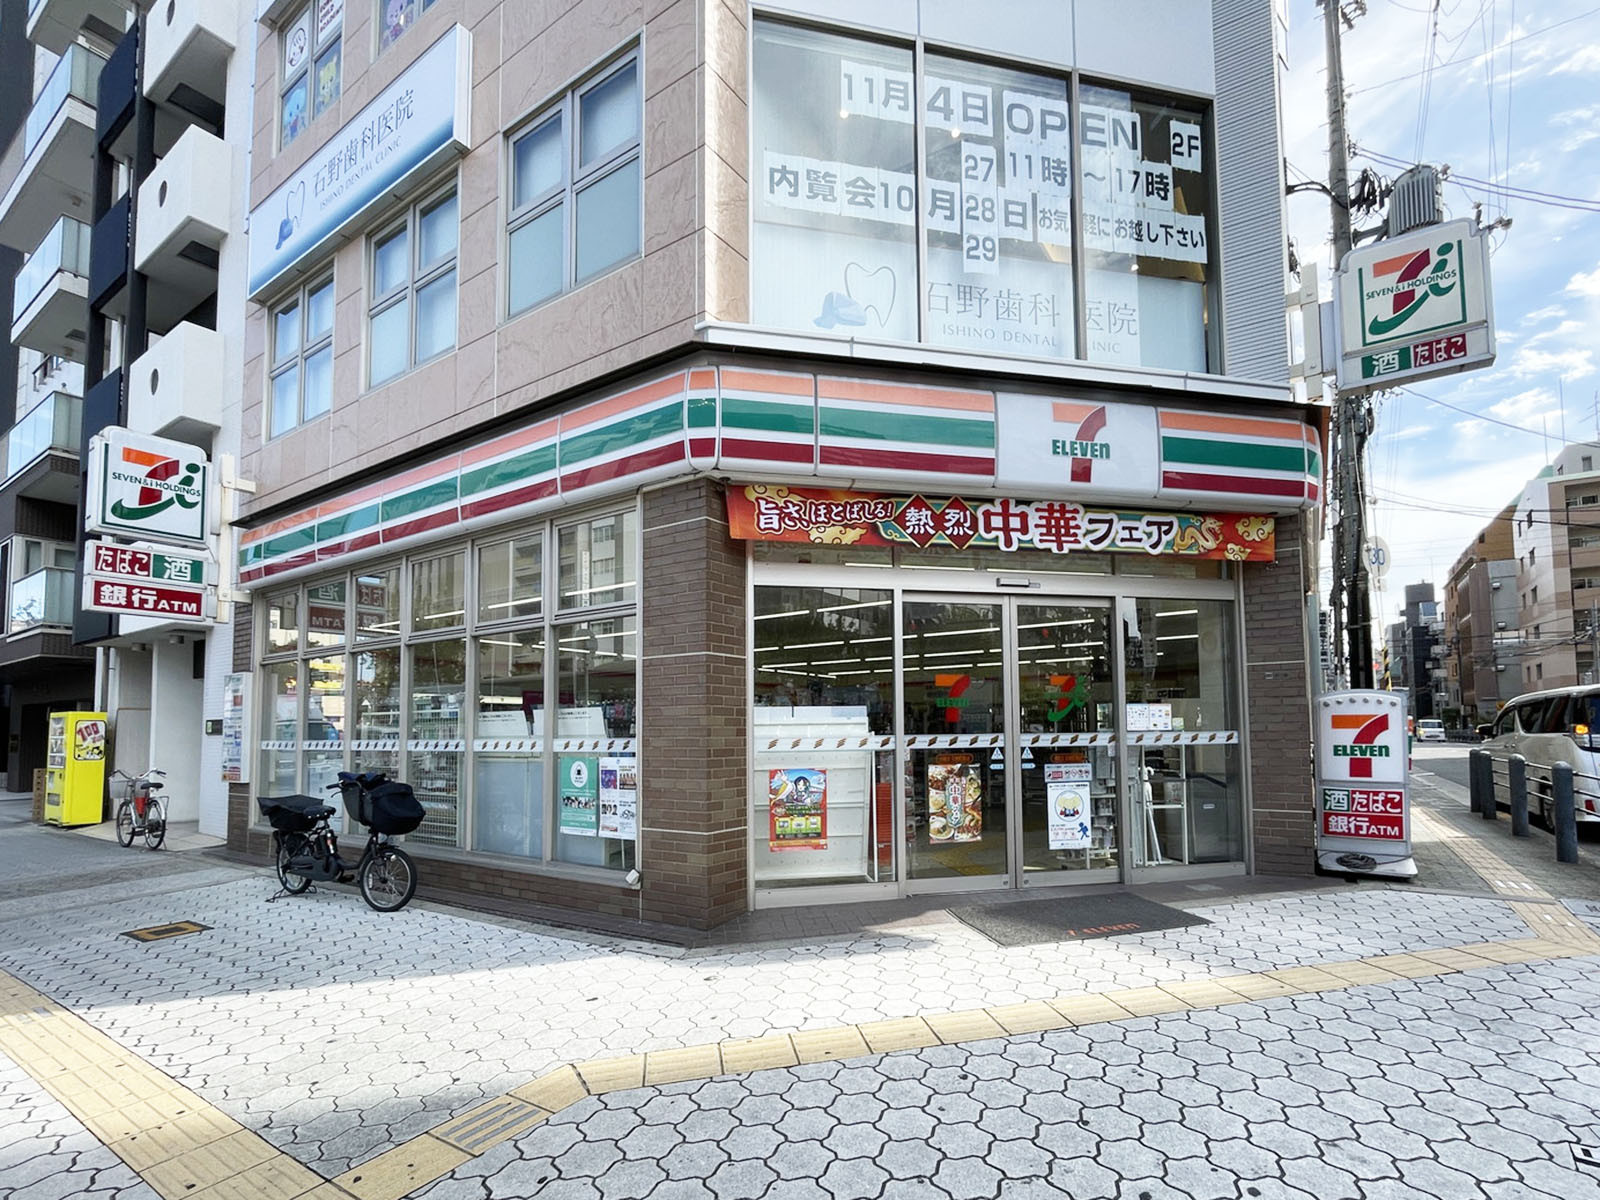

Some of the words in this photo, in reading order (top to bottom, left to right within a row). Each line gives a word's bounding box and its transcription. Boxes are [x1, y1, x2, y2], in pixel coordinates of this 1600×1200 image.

[1006, 103, 1139, 151] OPEN
[313, 89, 414, 198] 石野歯科医院
[1407, 269, 1457, 288] HOLDINGS
[943, 324, 996, 342] ISHINO
[1002, 329, 1058, 348] DENTAL
[1372, 350, 1400, 375] 酒
[1414, 336, 1466, 367] たばこ
[154, 480, 201, 498] HOLDINGS
[97, 547, 150, 577] たばこ
[164, 556, 193, 582] 酒
[1325, 789, 1350, 812] 酒
[1352, 791, 1402, 814] たばこ
